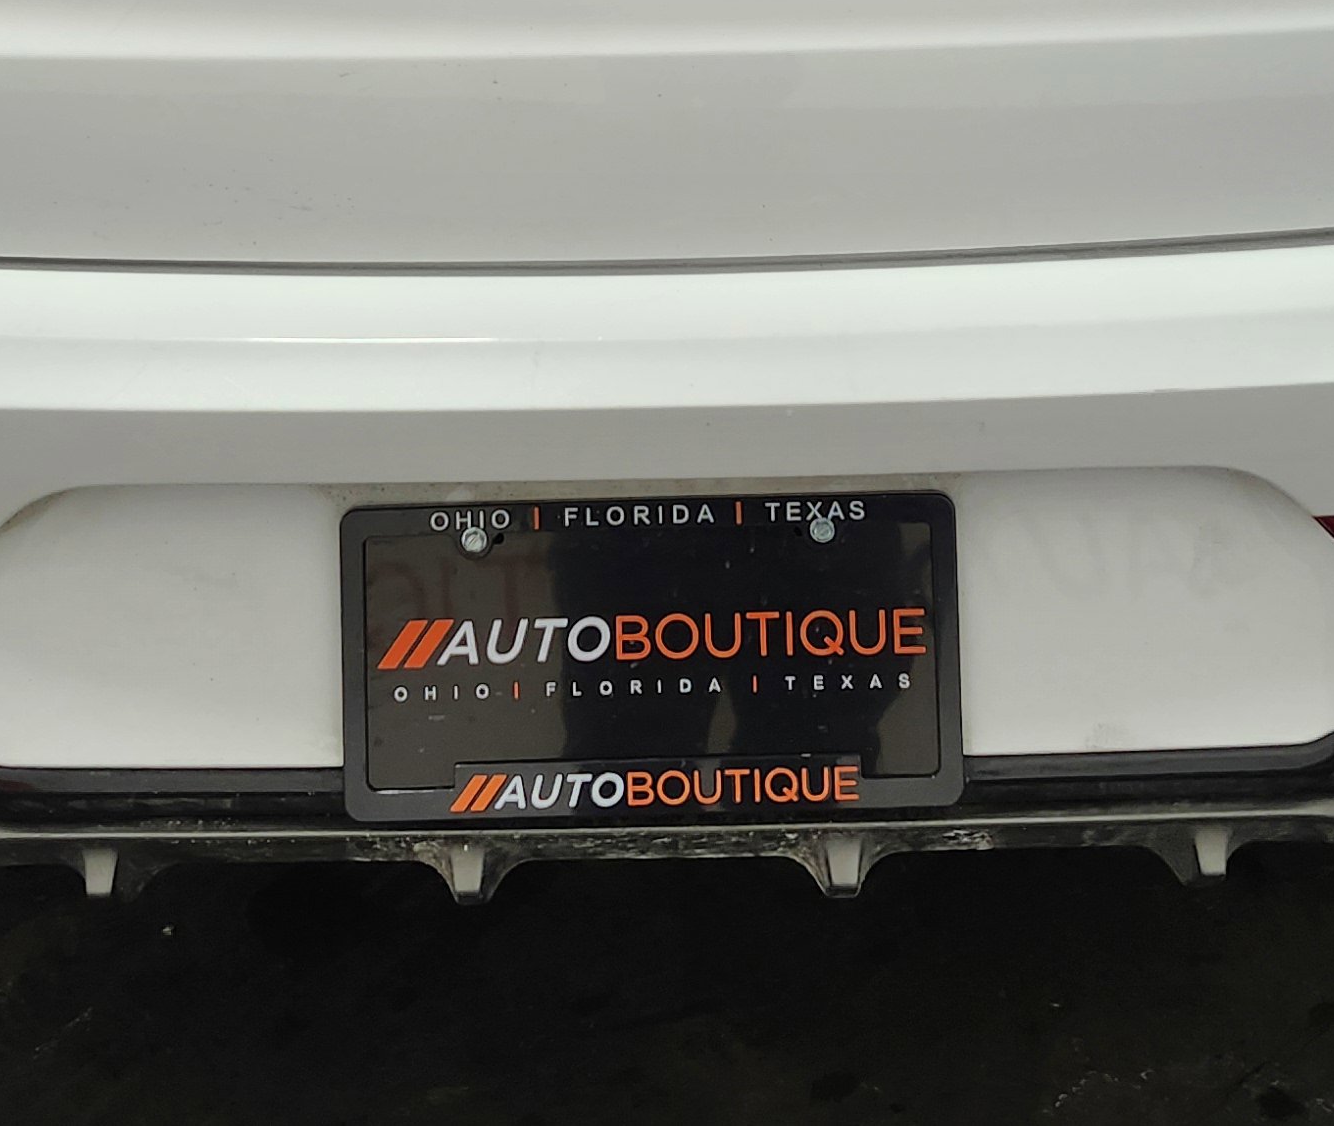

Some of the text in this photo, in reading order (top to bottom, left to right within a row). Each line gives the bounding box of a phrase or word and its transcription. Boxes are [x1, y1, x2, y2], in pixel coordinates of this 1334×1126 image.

[429, 500, 867, 532] OHIO FLORIDA TEXAS
[436, 606, 928, 667] AUTOBOUTIQUE
[392, 673, 912, 703] OHIO FLORIDA TEXAS
[494, 765, 860, 811] AUTOBOUTIQUE
